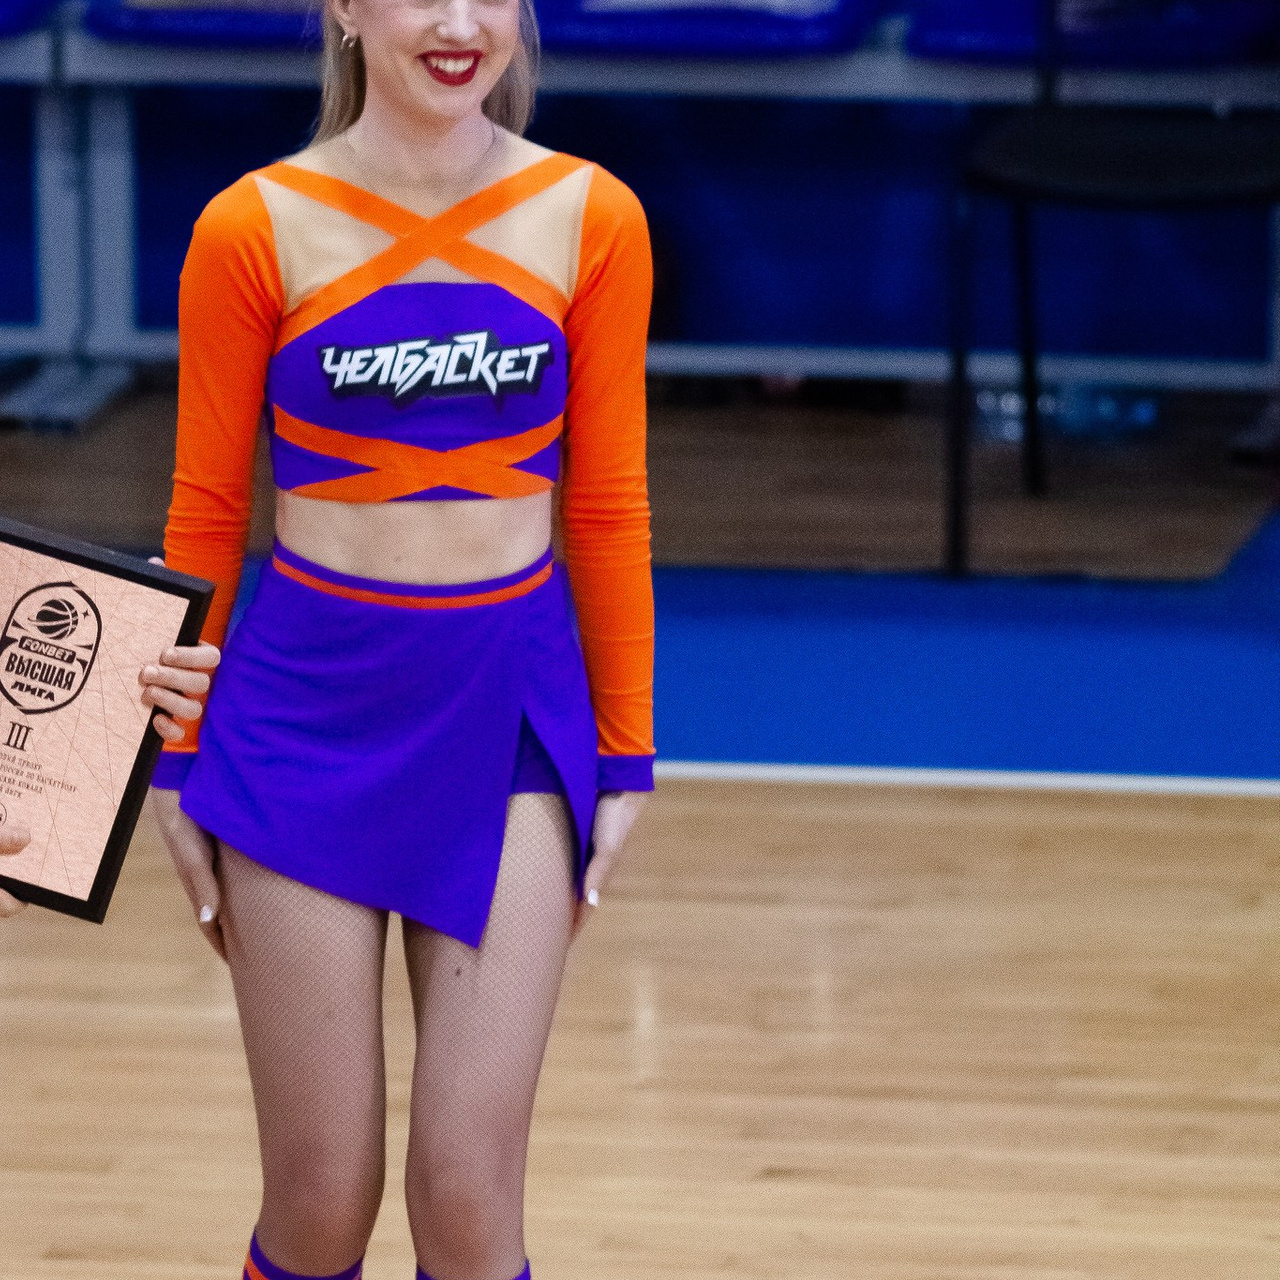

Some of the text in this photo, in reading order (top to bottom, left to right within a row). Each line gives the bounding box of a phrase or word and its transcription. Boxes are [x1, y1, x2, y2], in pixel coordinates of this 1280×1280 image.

[322, 331, 549, 397] ЧЕЛБАСКЕТ
[22, 639, 75, 661] FONBET
[5, 652, 76, 691] ВЫСШАЯ
[11, 681, 55, 701] ЛИГА
[2, 721, 34, 751] III
